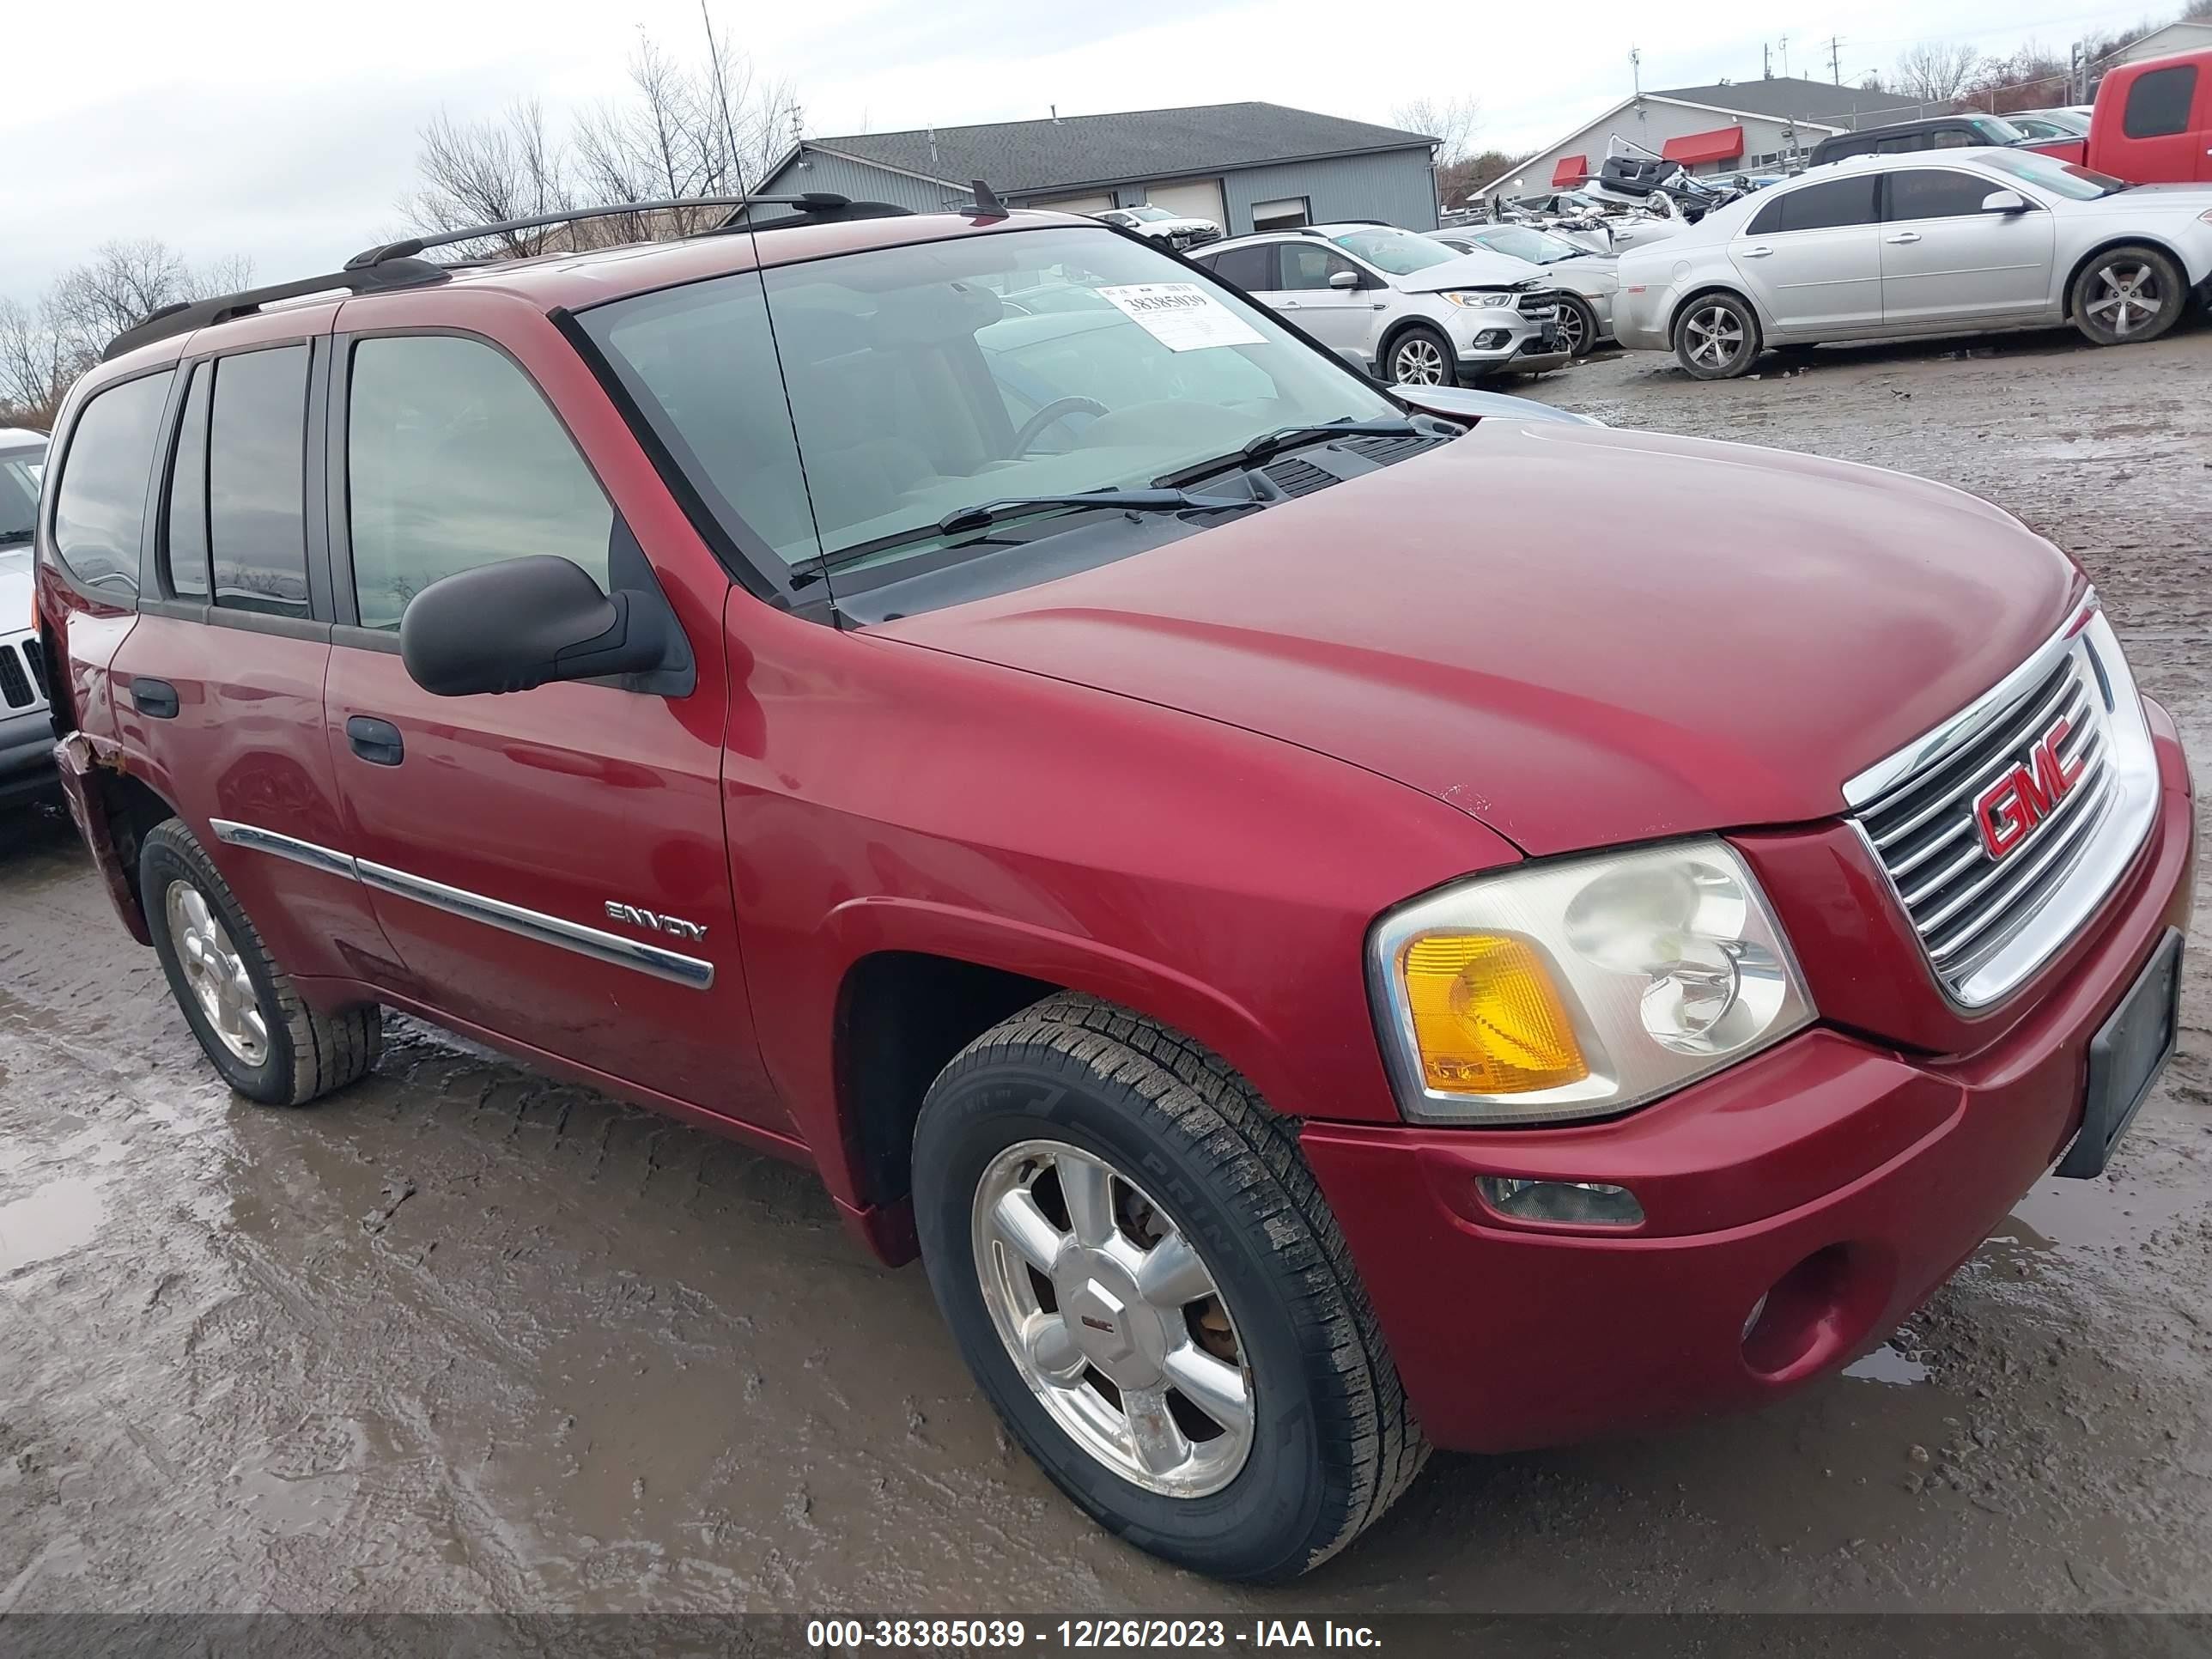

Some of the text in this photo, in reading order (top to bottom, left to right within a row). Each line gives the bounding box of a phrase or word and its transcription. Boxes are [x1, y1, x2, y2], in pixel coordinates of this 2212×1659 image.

[1124, 295, 1206, 311] 38385039
[1973, 714, 2085, 861] GMC
[605, 900, 708, 941] ENVOY
